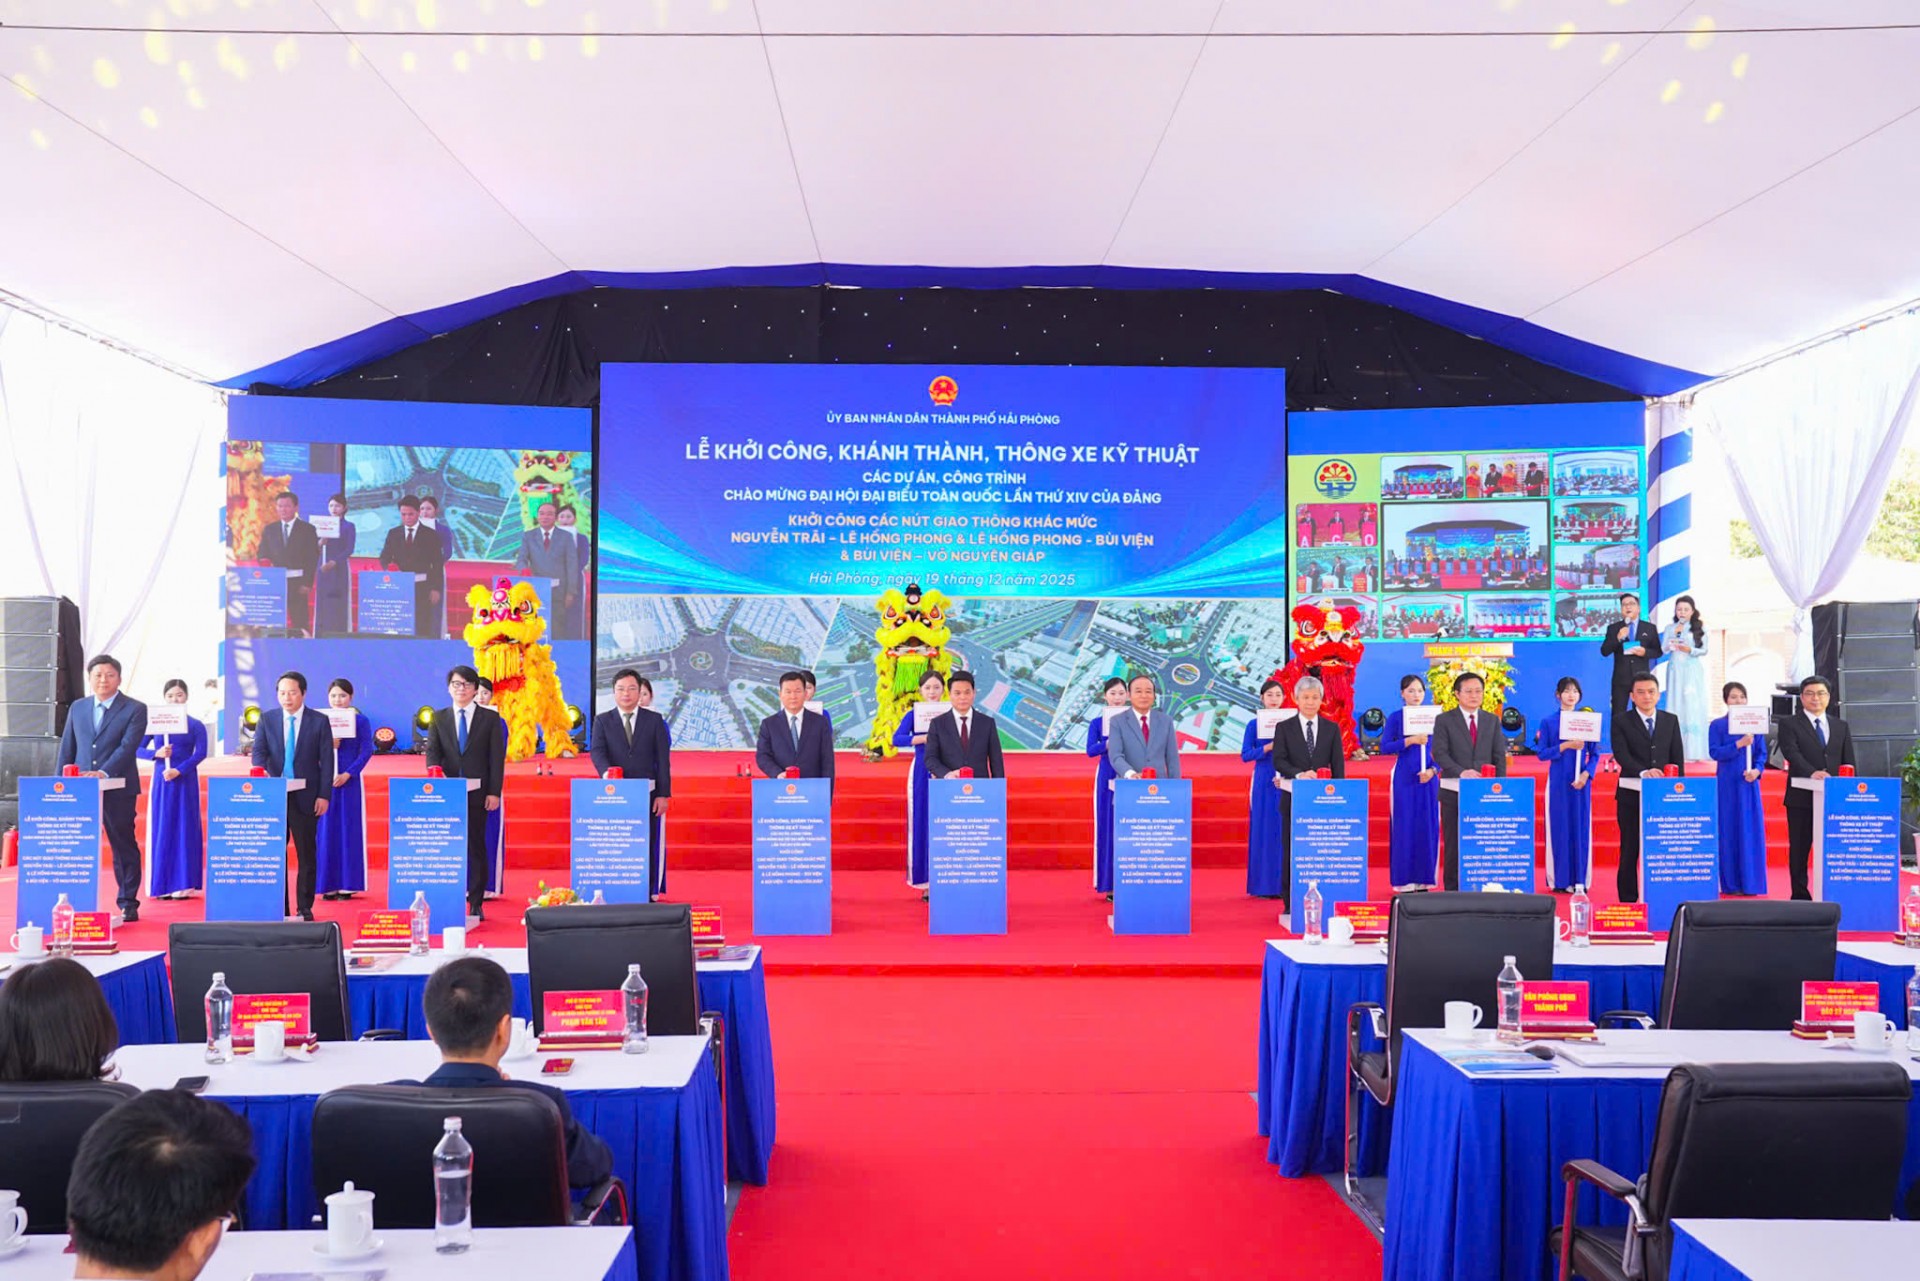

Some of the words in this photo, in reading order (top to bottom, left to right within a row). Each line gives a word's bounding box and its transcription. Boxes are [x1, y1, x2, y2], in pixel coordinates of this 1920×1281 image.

[826, 410, 842, 423] ỦY
[844, 413, 868, 423] BAN
[870, 412, 902, 423] NHÂN
[904, 412, 929, 424] DÂN
[930, 411, 970, 424] THÀNH
[972, 410, 997, 424] PHỐ
[998, 411, 1018, 424] HẢI
[1019, 412, 1060, 425] PHÒNG
[686, 436, 710, 460] LỄ
[714, 438, 763, 460] KHỞI
[767, 440, 833, 462] CÔNG,
[838, 440, 909, 461] KHÁNH
[914, 441, 989, 463] THÀNH,
[995, 441, 1067, 463] THÔNG
[1071, 446, 1097, 462] XE
[1102, 442, 1129, 463] KỸ
[1134, 443, 1200, 468] THUẬT
[862, 469, 891, 483] CÁC
[894, 471, 914, 485] DỰ
[916, 470, 940, 484] ÁN,
[943, 471, 983, 484] CÔNG
[985, 470, 1026, 484] TRÌNH
[723, 487, 763, 501] CHÀO
[765, 486, 807, 501] MỪNG
[809, 490, 833, 504] ĐẠI
[835, 489, 859, 504] HỘI
[861, 490, 885, 505] ĐẠI
[888, 484, 919, 502] BIỂU
[921, 489, 959, 503] TOÀN
[961, 487, 1001, 503] QUỐC
[1004, 487, 1033, 503] LẦN
[1035, 490, 1064, 503] THỨ
[1065, 492, 1089, 503] XIV
[1091, 489, 1121, 504] CỦA
[1122, 489, 1162, 504] ĐẢNG
[788, 511, 822, 527] KHỞI
[824, 513, 866, 527] CÔNG
[869, 513, 899, 527] CÁC
[901, 513, 931, 527] NÚT
[932, 516, 968, 527] GIAO
[971, 515, 1021, 528] THÔNG
[1023, 514, 1063, 529] KHÁC
[1065, 514, 1098, 529] MỨC
[731, 527, 790, 544] NGUYỄN
[792, 531, 826, 544] TRÃI
[839, 531, 857, 544] LÊ
[860, 529, 901, 545] HỒNG
[904, 533, 954, 545] PHONG
[956, 534, 966, 545] &
[968, 532, 986, 545] LÊ
[989, 530, 1030, 545] HỒNG
[1032, 534, 1083, 546] PHONG
[1095, 532, 1119, 546] BÙI
[1121, 532, 1155, 549] VIỆN
[840, 550, 850, 561] &
[853, 548, 877, 561] BÙI
[879, 549, 913, 565] VIỆN
[927, 548, 949, 562] VÕ
[950, 549, 1009, 563] NGUYÊN
[1011, 548, 1046, 563] GIÁP
[809, 571, 832, 584] Hải
[835, 572, 882, 587] Phòng,
[925, 573, 939, 584] 19
[943, 573, 984, 588] tháng
[987, 574, 1002, 585] 12
[1005, 574, 1036, 586] năm
[1039, 573, 1076, 586] 2025
[1534, 1002, 1555, 1011] THÀNH
[1555, 1002, 1568, 1011] PHỐ
